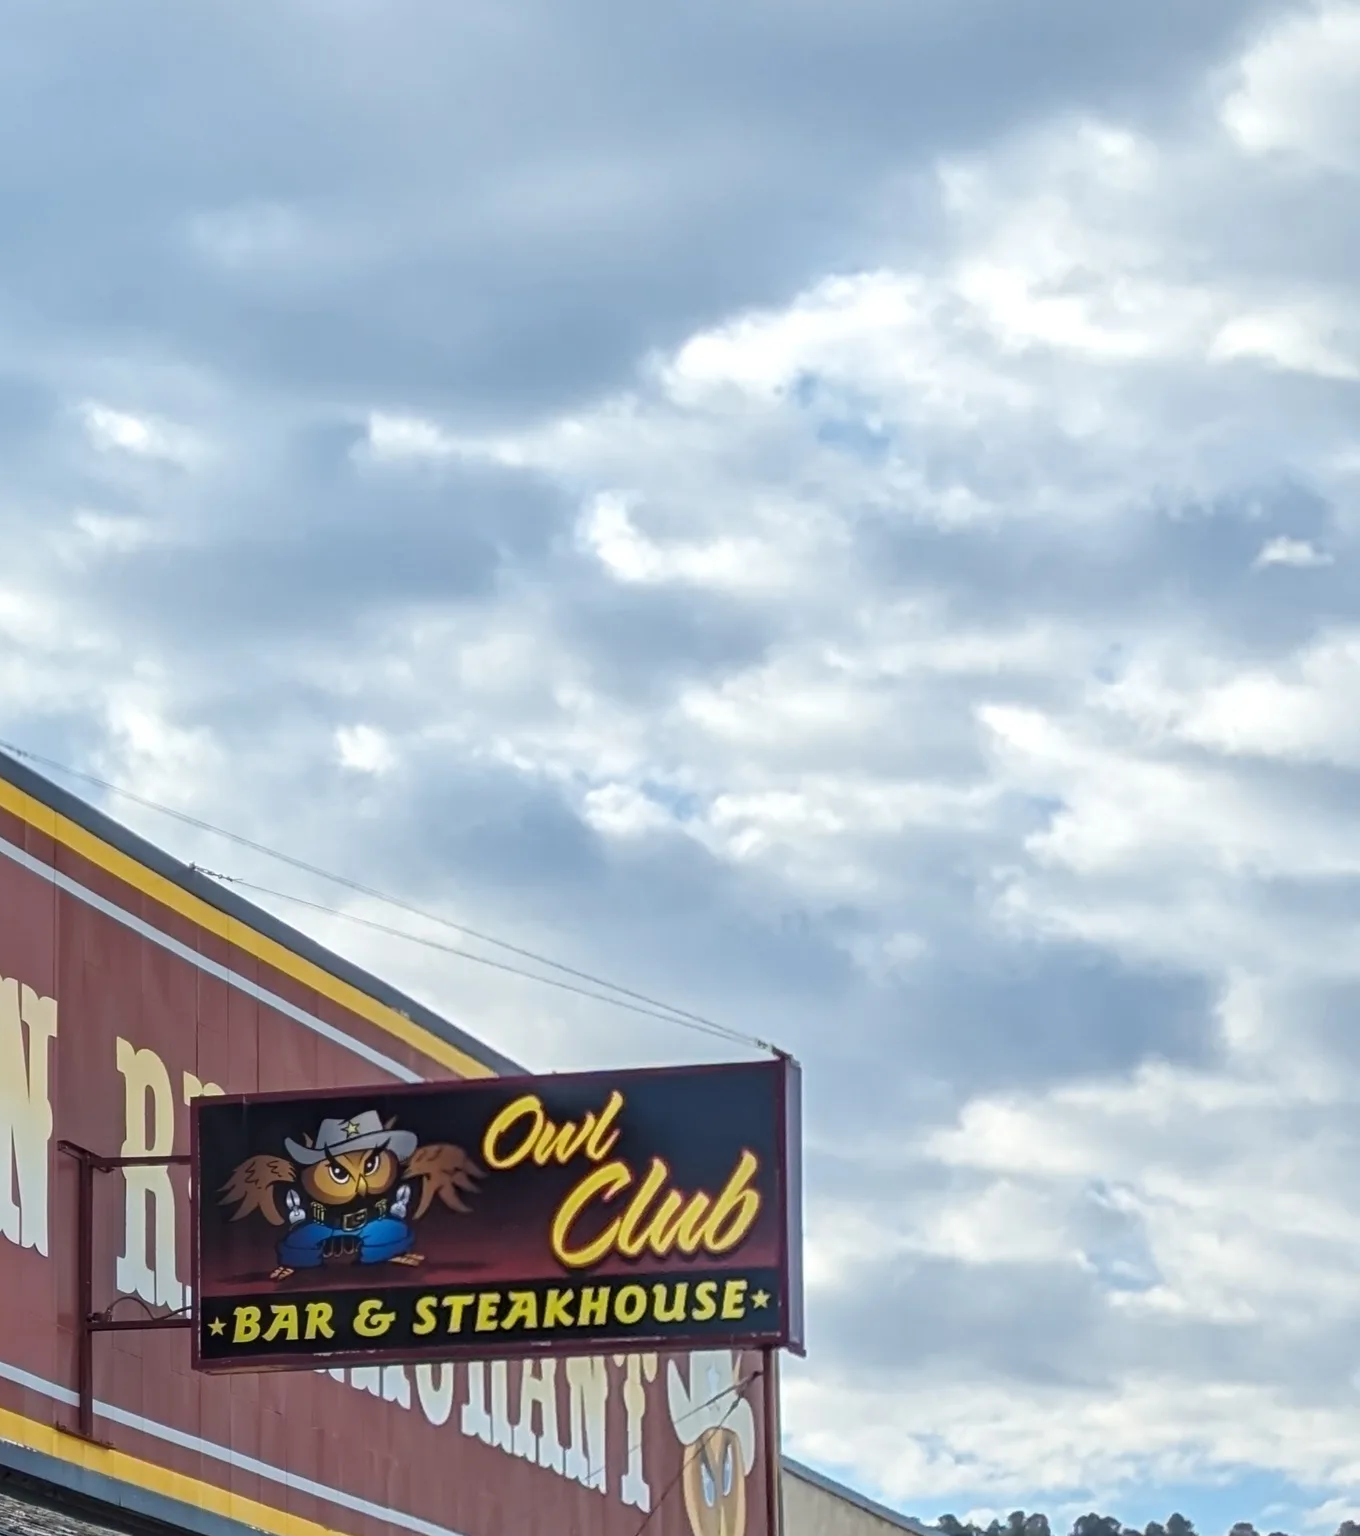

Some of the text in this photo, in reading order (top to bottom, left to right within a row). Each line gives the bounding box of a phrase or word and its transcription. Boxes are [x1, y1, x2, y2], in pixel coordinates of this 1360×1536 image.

[483, 1090, 625, 1169] Owl
[552, 1149, 760, 1268] Club
[231, 1279, 749, 1343] BAR & STEAKHOUSE
